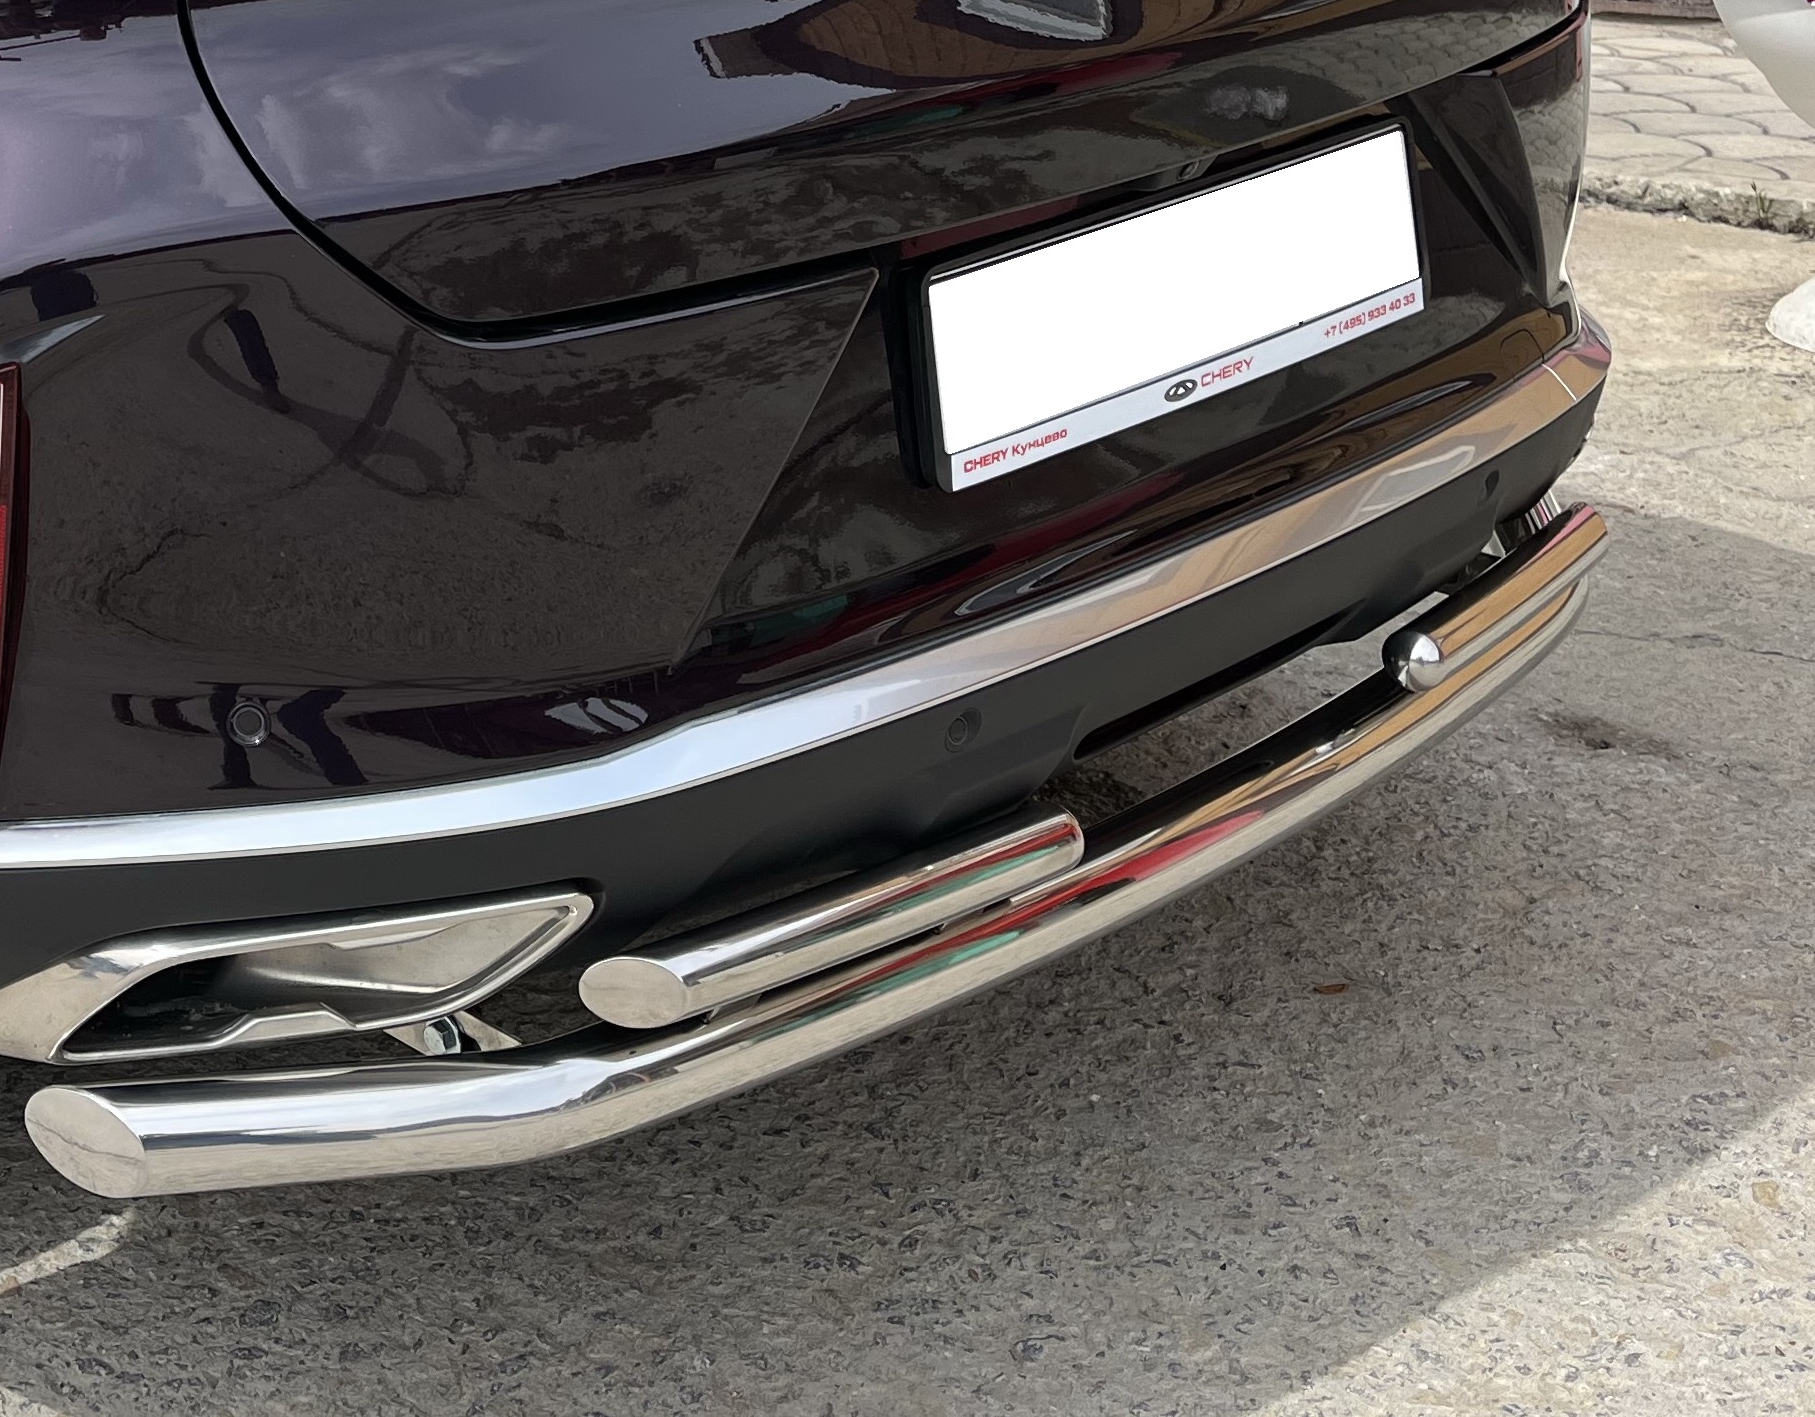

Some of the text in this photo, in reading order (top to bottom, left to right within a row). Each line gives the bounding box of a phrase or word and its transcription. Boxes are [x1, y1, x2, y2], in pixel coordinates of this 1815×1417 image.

[1324, 292, 1416, 338] +7 (495) 933 40 33
[1200, 356, 1254, 387] CHERY
[963, 429, 1068, 474] CHERY Кунцево
